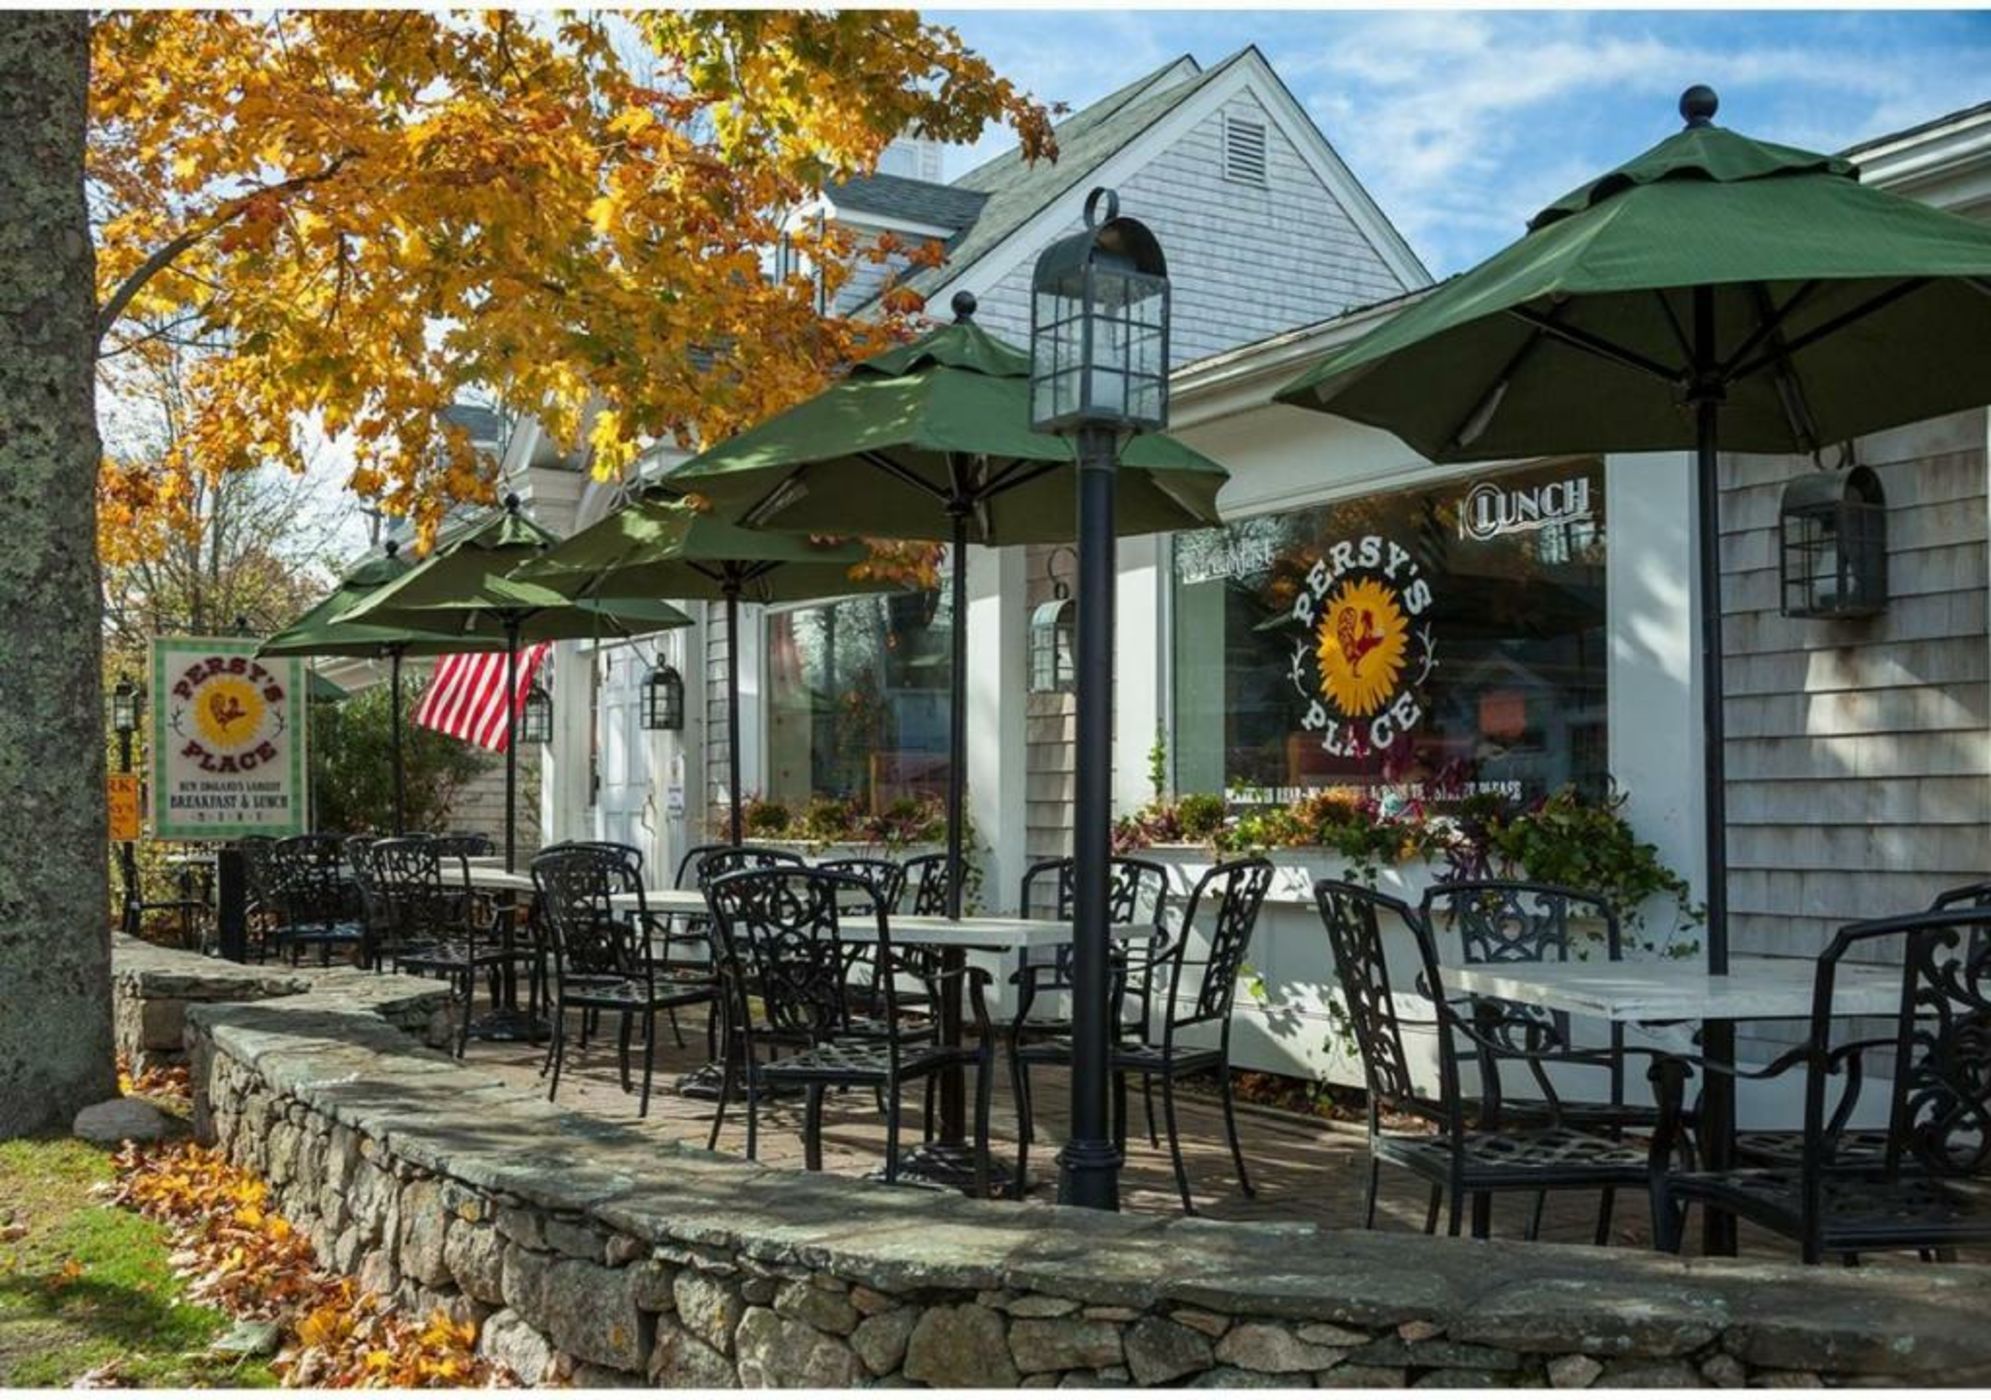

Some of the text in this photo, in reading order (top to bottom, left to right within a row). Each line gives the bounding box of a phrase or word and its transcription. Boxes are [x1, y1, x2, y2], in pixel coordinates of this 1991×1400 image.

[1463, 476, 1590, 541] LUNCH
[1292, 535, 1433, 629] PERSY'S
[172, 657, 286, 702] PERSY'S
[1300, 691, 1422, 758] PLACE
[181, 739, 278, 774] PLACE
[171, 794, 288, 809] BREAKFAST & LUNCH
